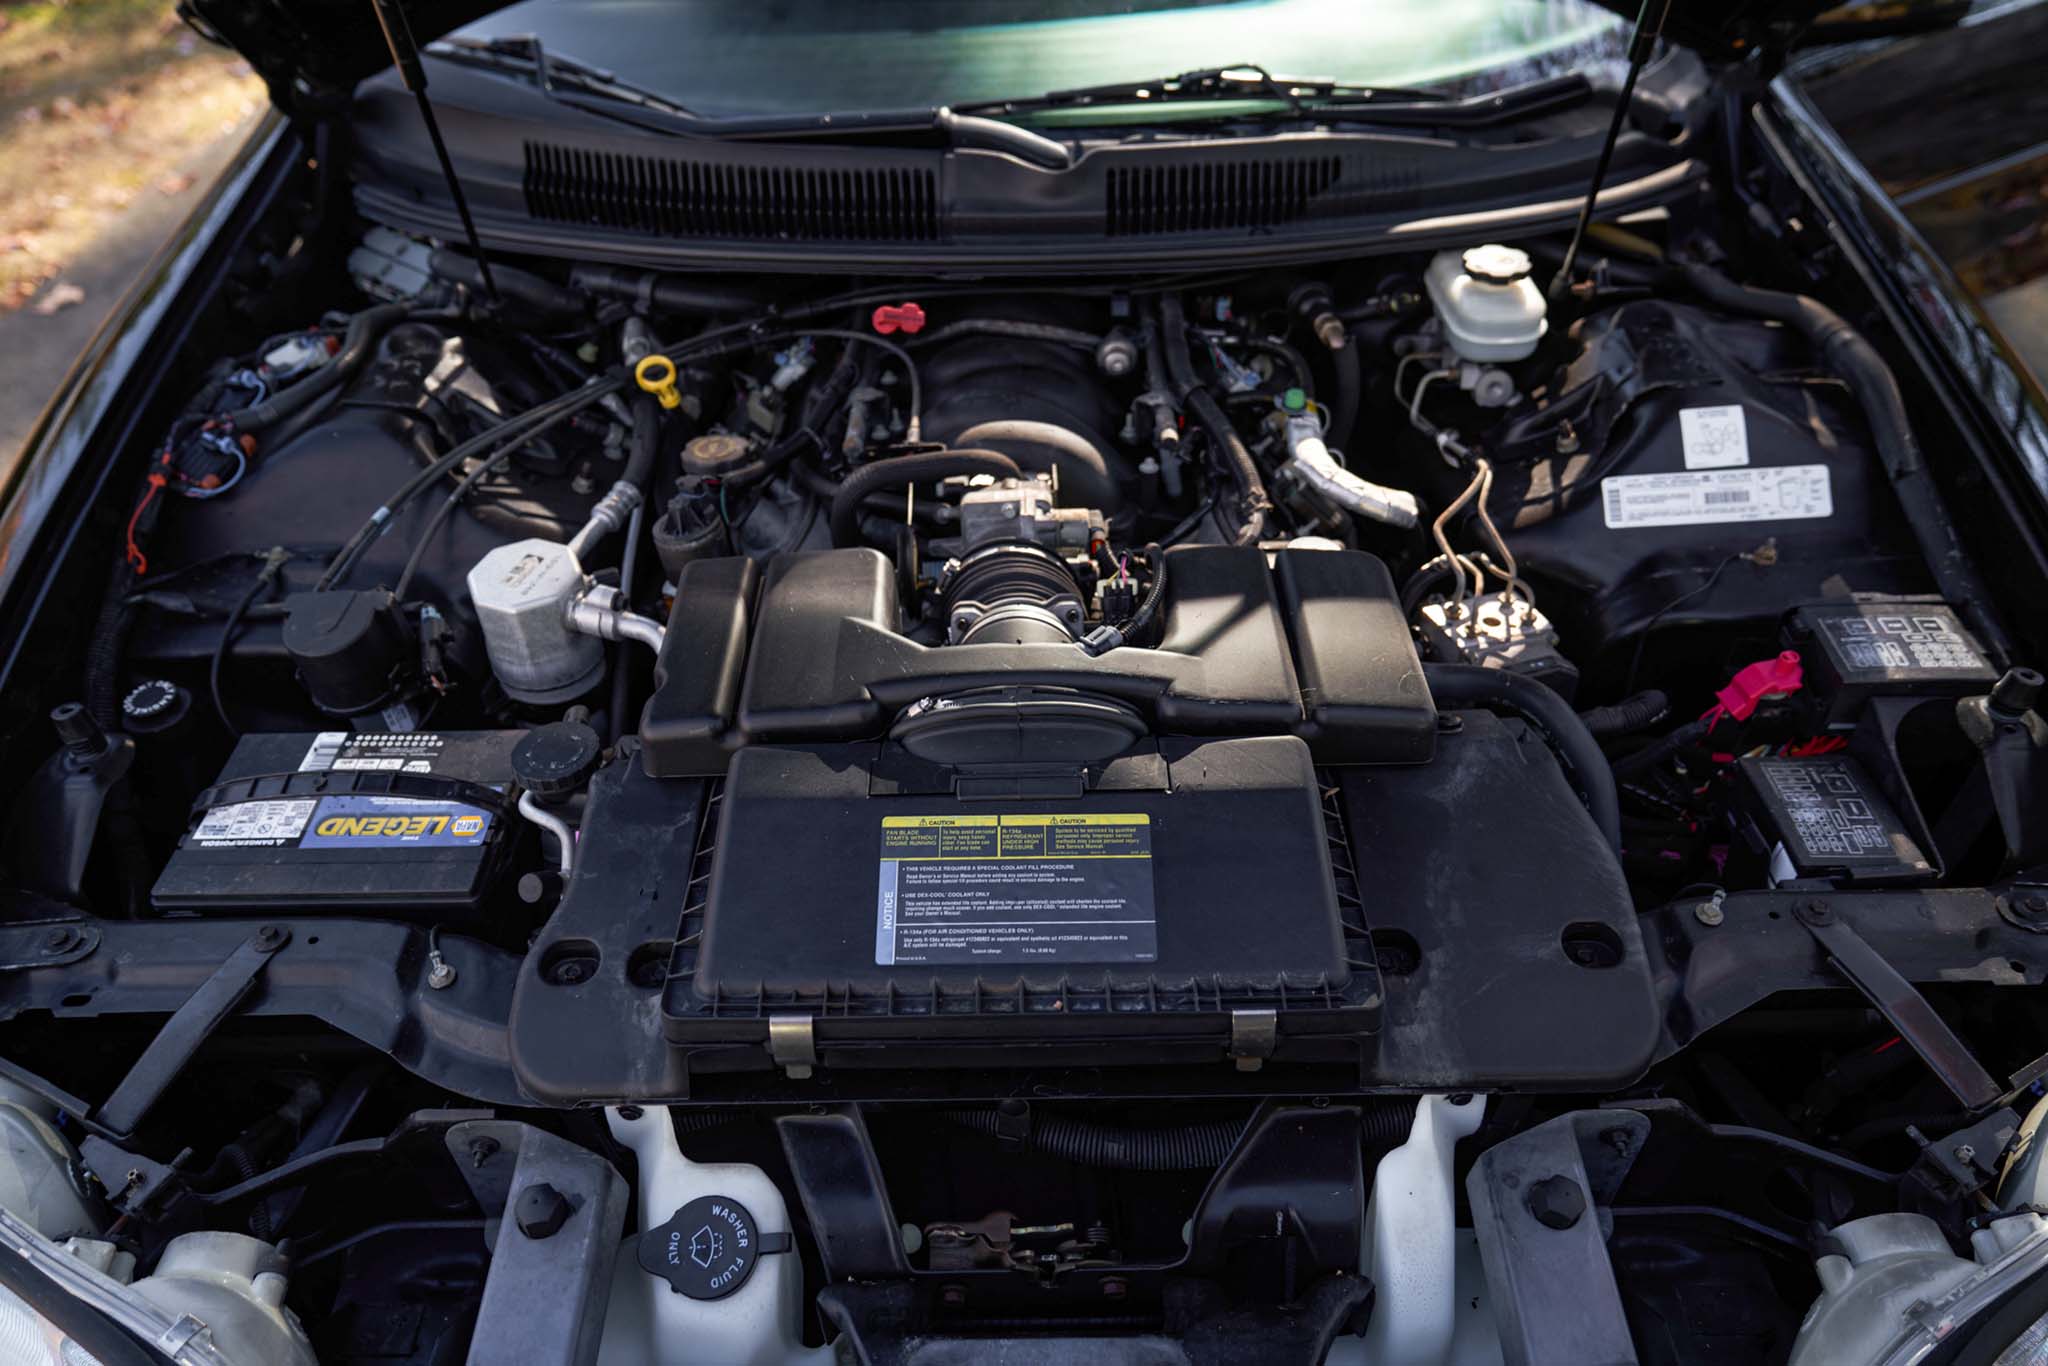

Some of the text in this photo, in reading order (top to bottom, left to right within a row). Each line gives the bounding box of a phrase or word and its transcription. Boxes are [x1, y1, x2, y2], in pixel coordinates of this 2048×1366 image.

[316, 816, 451, 837] LEGEND
[455, 821, 480, 832] NAPA
[882, 891, 894, 930] NOTICE
[668, 1232, 681, 1265] ONLY
[710, 1204, 749, 1288] WASHER FLUID
